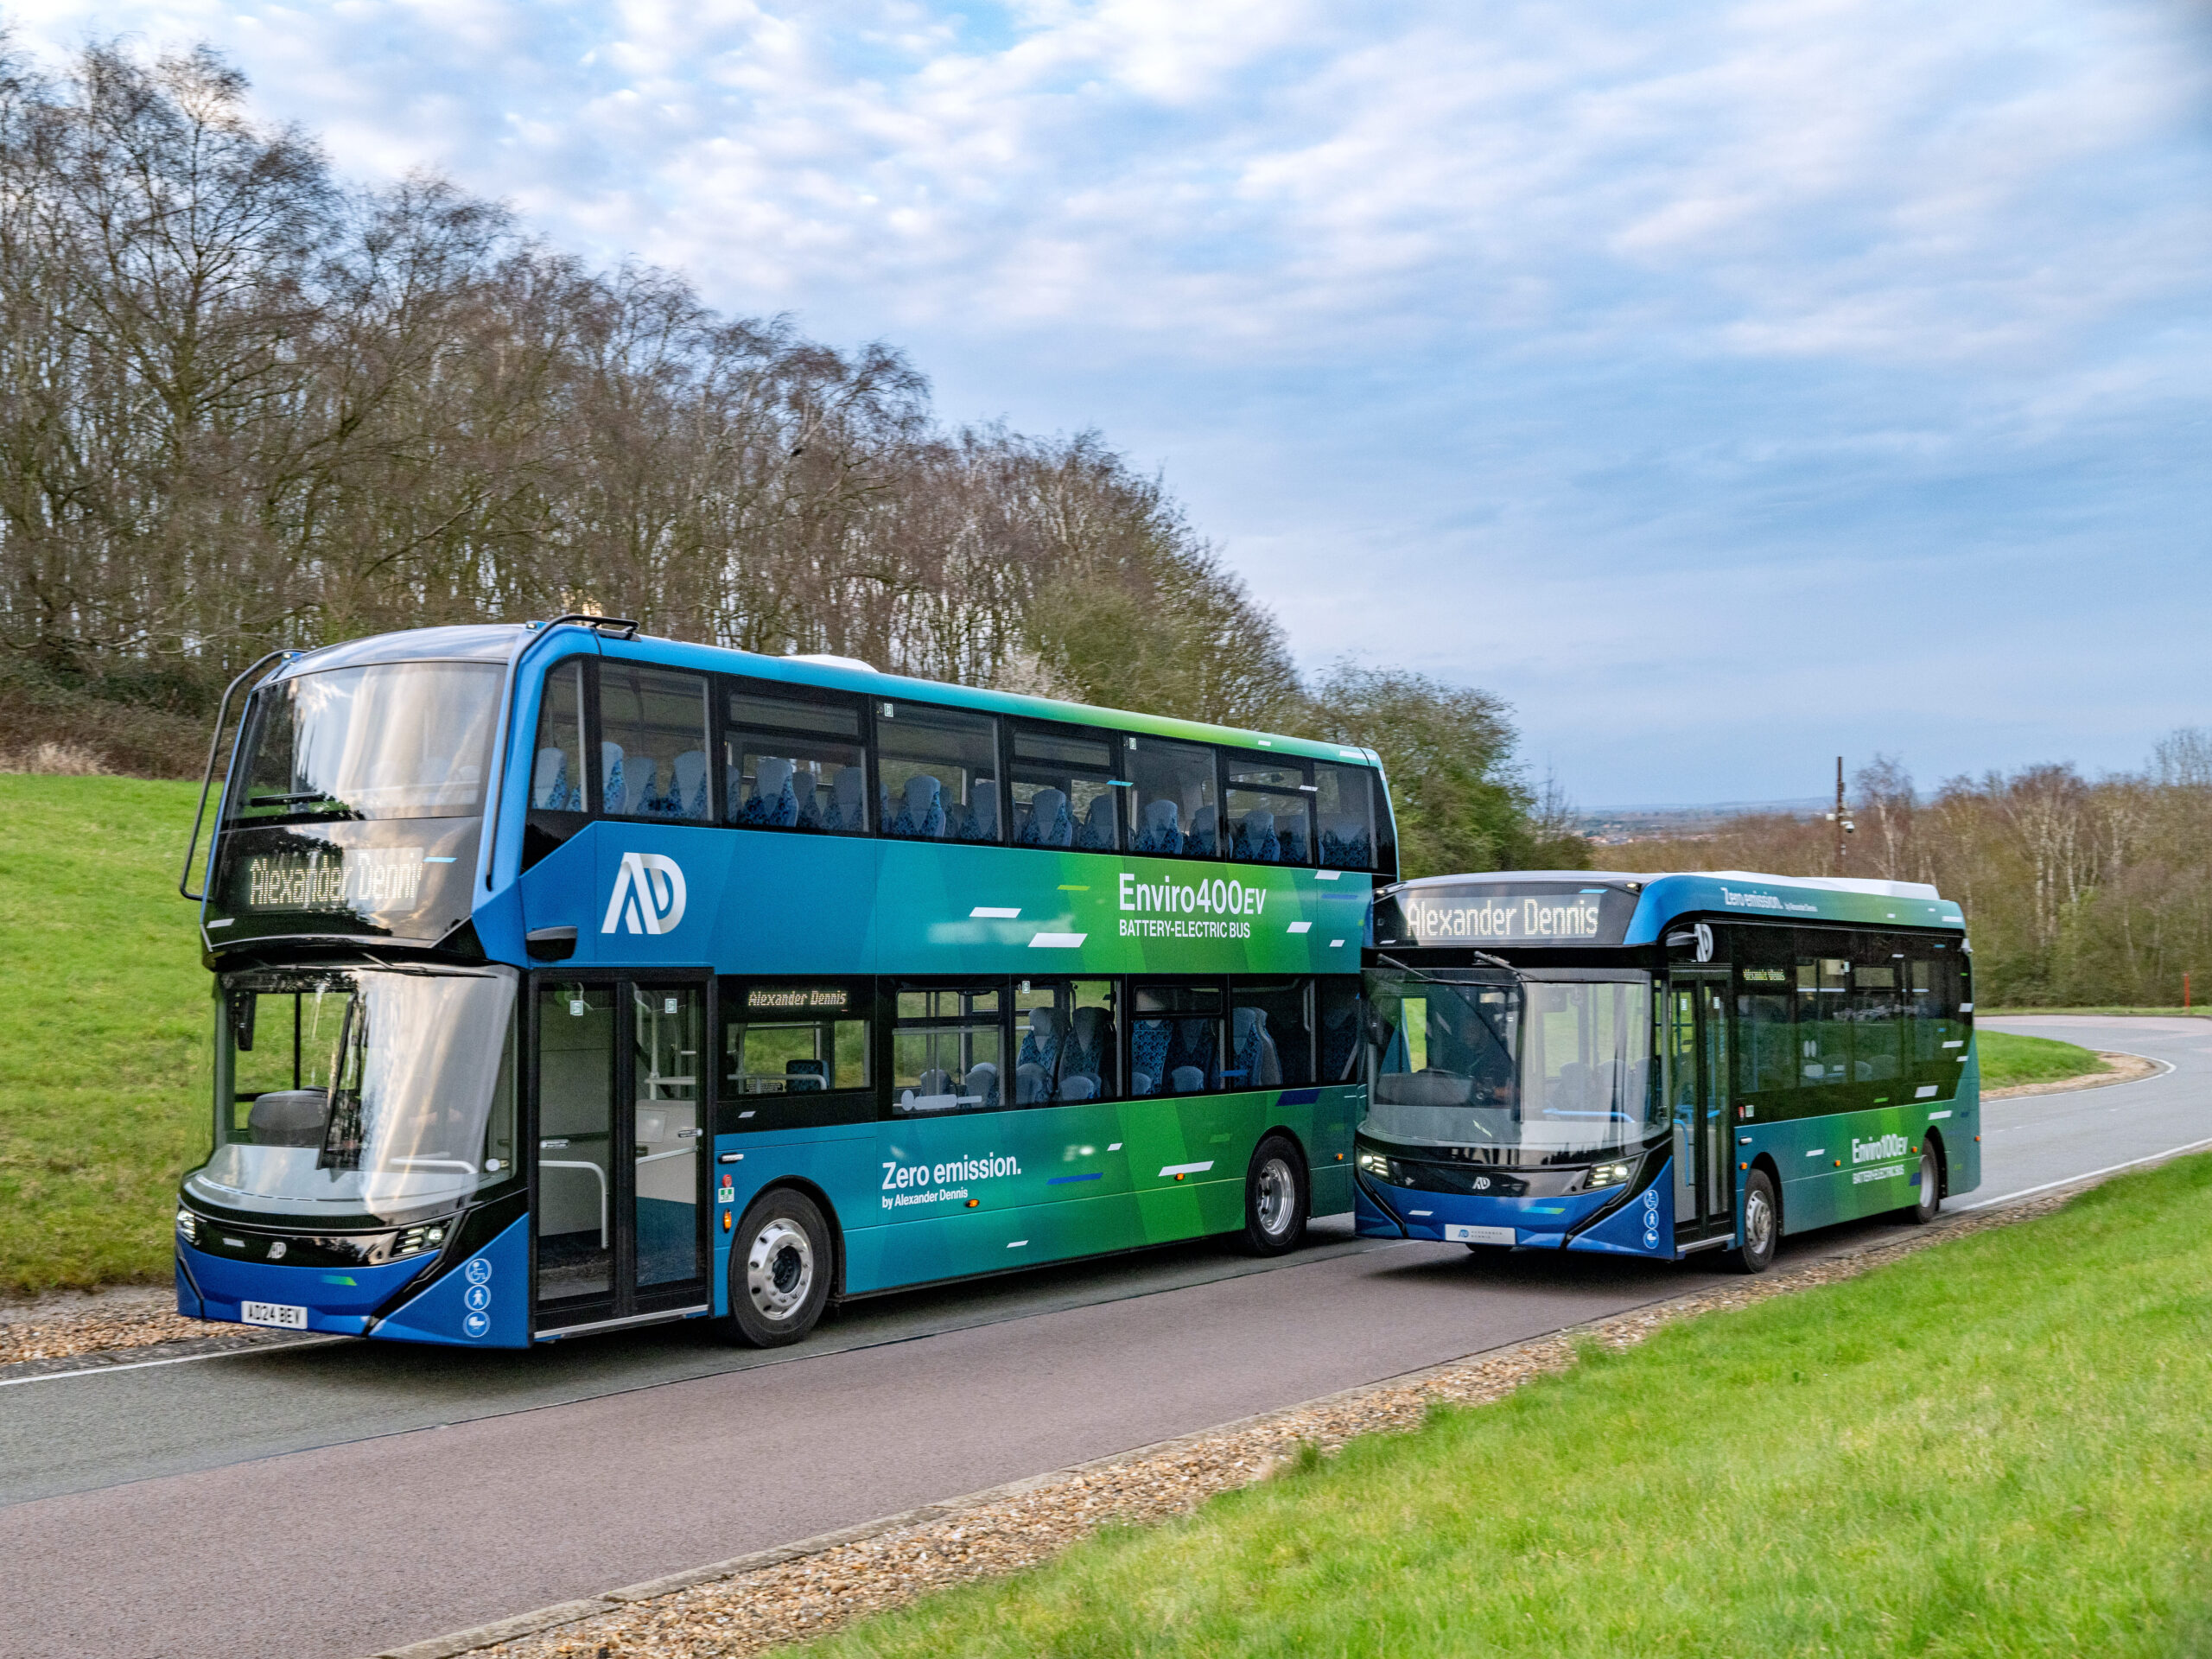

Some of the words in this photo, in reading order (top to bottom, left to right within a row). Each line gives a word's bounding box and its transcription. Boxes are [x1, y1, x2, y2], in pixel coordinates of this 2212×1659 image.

[249, 855, 353, 906] Alexander
[1119, 918, 1227, 938] BATTERY-ELECTRIC
[1229, 922, 1250, 938] BUS
[1407, 899, 1517, 937] Alexander
[1523, 899, 1599, 935] Dennis
[748, 990, 808, 1006] Alexander
[810, 989, 847, 1005] Dennis
[881, 1161, 930, 1191] Zero
[933, 1151, 1022, 1185] emission.
[881, 1196, 893, 1211] by
[894, 1192, 938, 1207] Alexander
[939, 1186, 969, 1201] Dennis
